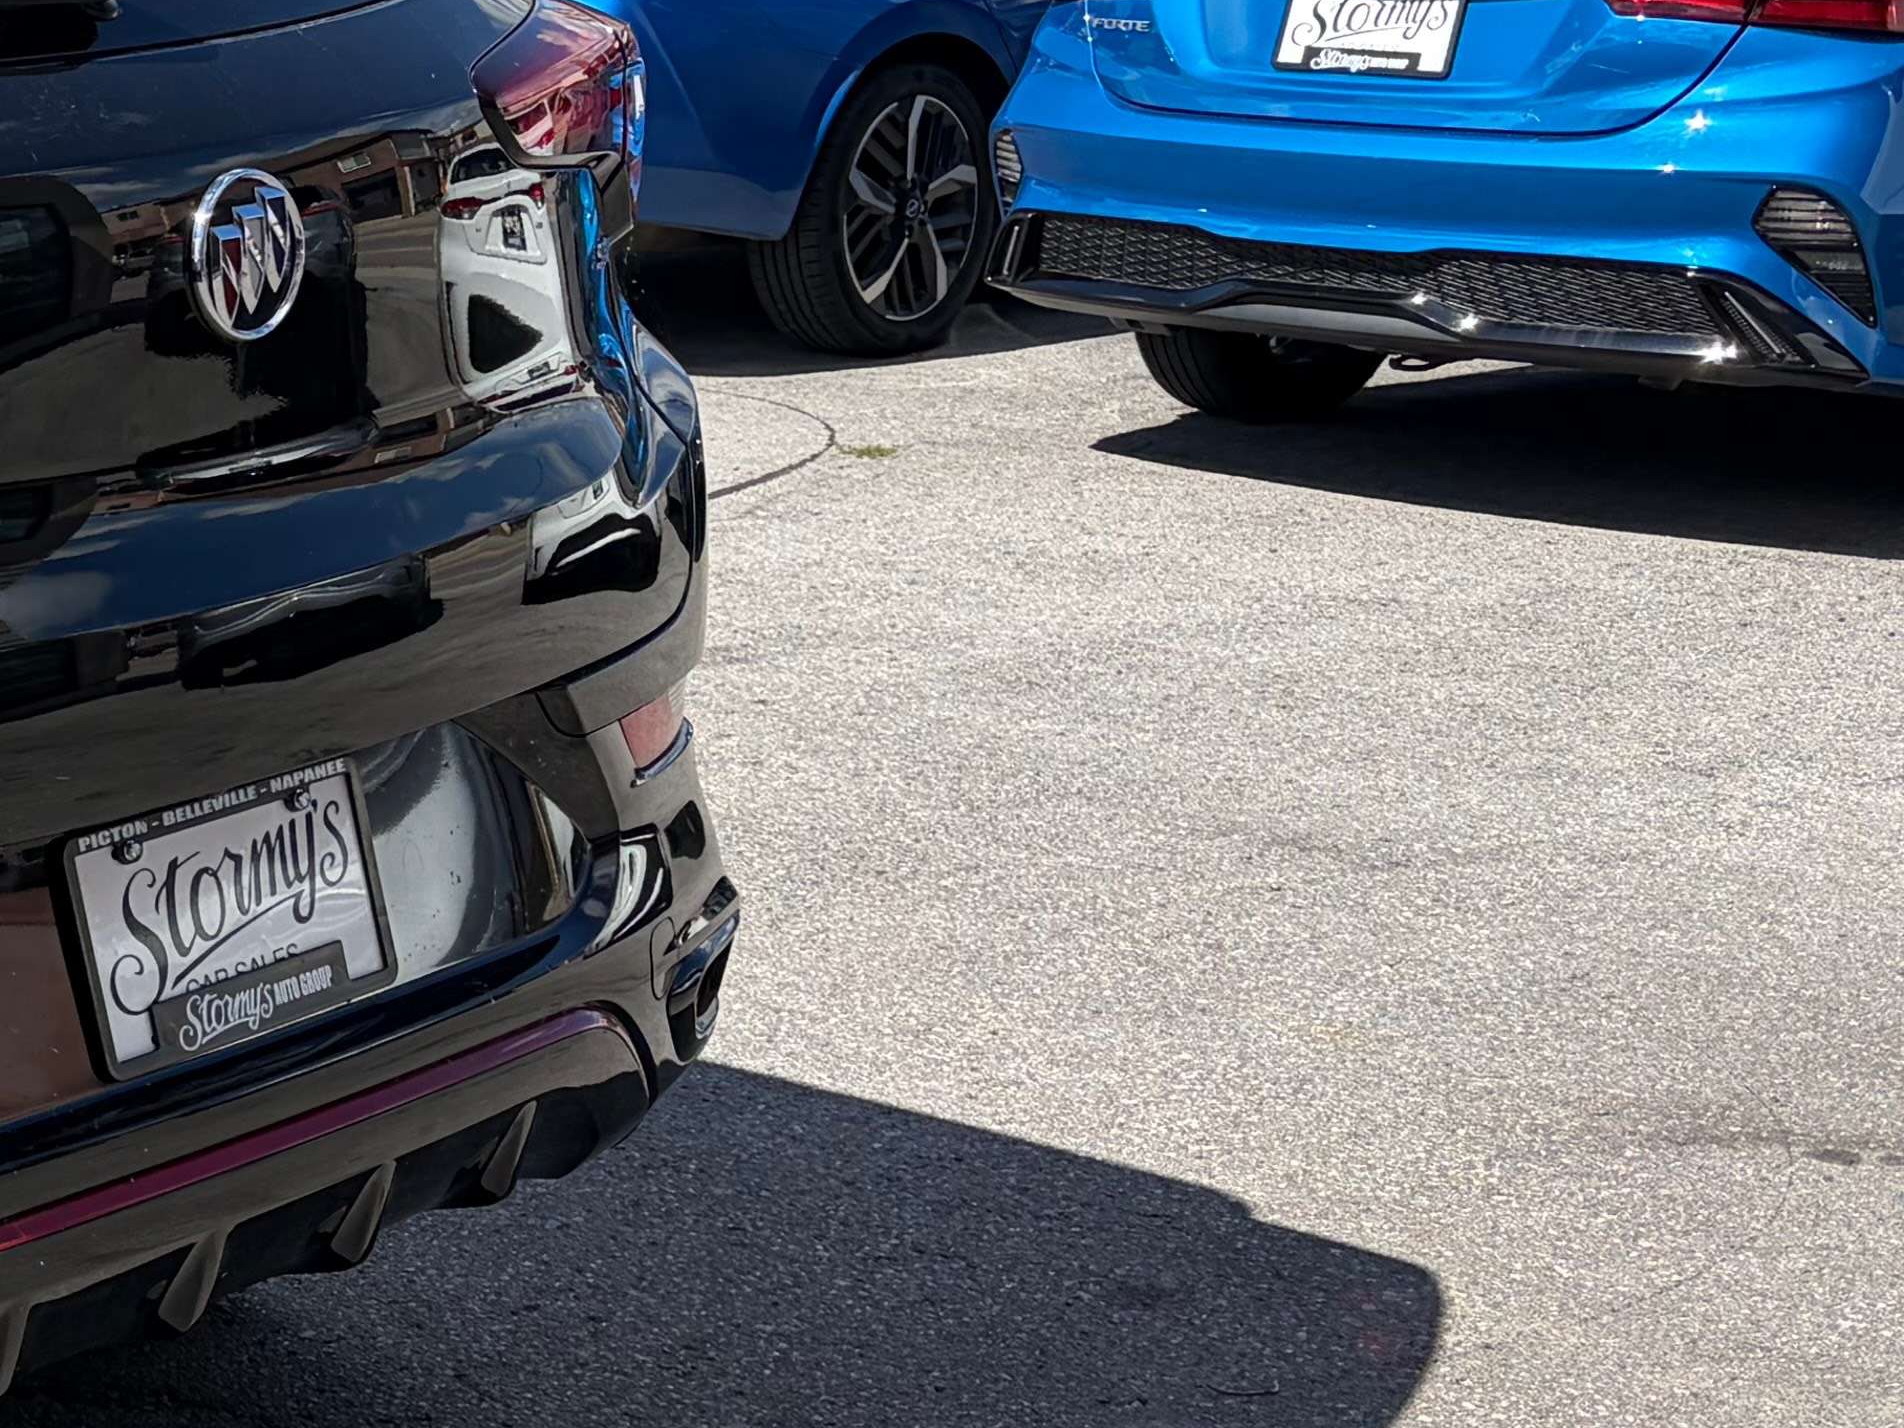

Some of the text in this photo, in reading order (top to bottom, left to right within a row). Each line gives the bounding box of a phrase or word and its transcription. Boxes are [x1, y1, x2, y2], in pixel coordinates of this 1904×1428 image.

[1092, 17, 1150, 32] FORTE
[78, 819, 148, 853] PICTON
[162, 785, 257, 828] BELLEVILLE
[270, 758, 346, 793] NAPANEE
[110, 800, 349, 1016] Stormy's
[179, 965, 333, 1051] Stormy's AUTO GROUP
